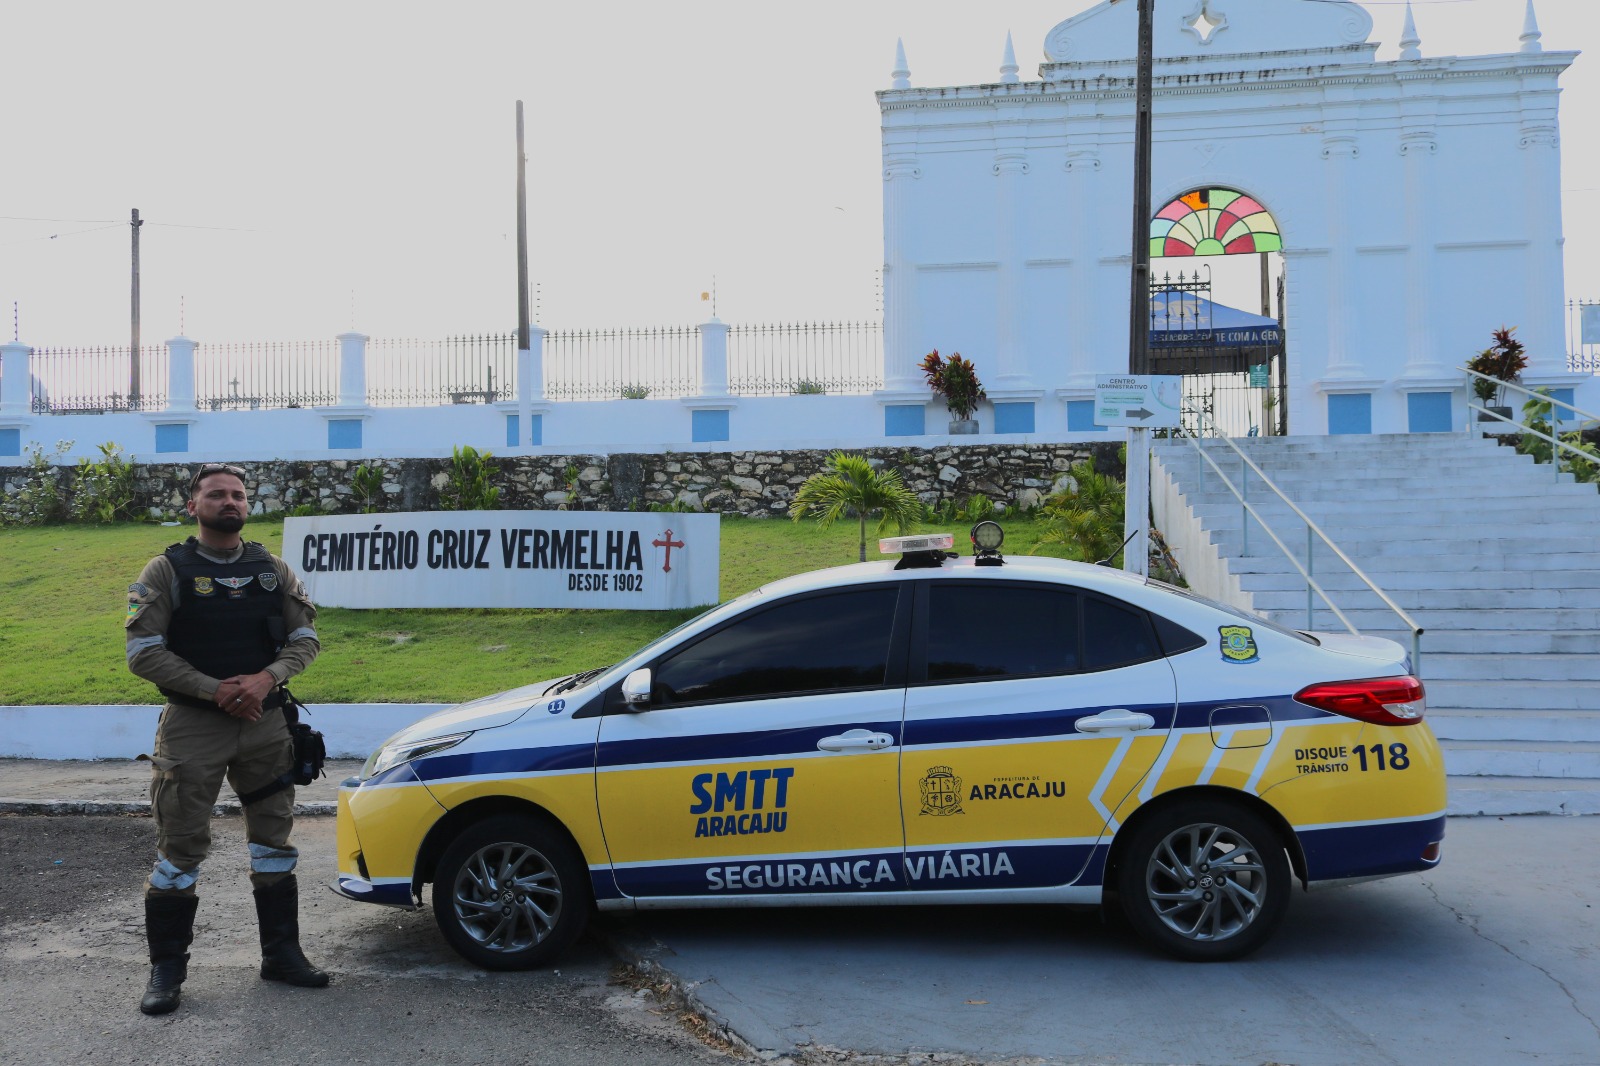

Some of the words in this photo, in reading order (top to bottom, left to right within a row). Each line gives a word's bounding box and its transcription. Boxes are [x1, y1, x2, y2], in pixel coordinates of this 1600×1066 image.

[1228, 331, 1249, 342] COM
[302, 524, 419, 573] CEMITÉRIO
[427, 528, 491, 570] CRUZ
[500, 528, 644, 571] VERMELHA
[568, 573, 609, 592] DESDE
[612, 573, 643, 592] 1902
[549, 700, 563, 712] 11
[1294, 746, 1348, 760] DISQUE
[1351, 742, 1410, 772] 118
[1296, 763, 1349, 774] TRÂNSITO
[690, 767, 795, 815] SMTT
[969, 781, 1066, 801] ARACAJU
[694, 811, 788, 838] ARACAJU
[705, 858, 896, 890] SEGURANÇA
[904, 850, 1015, 881] VIÁRIA
